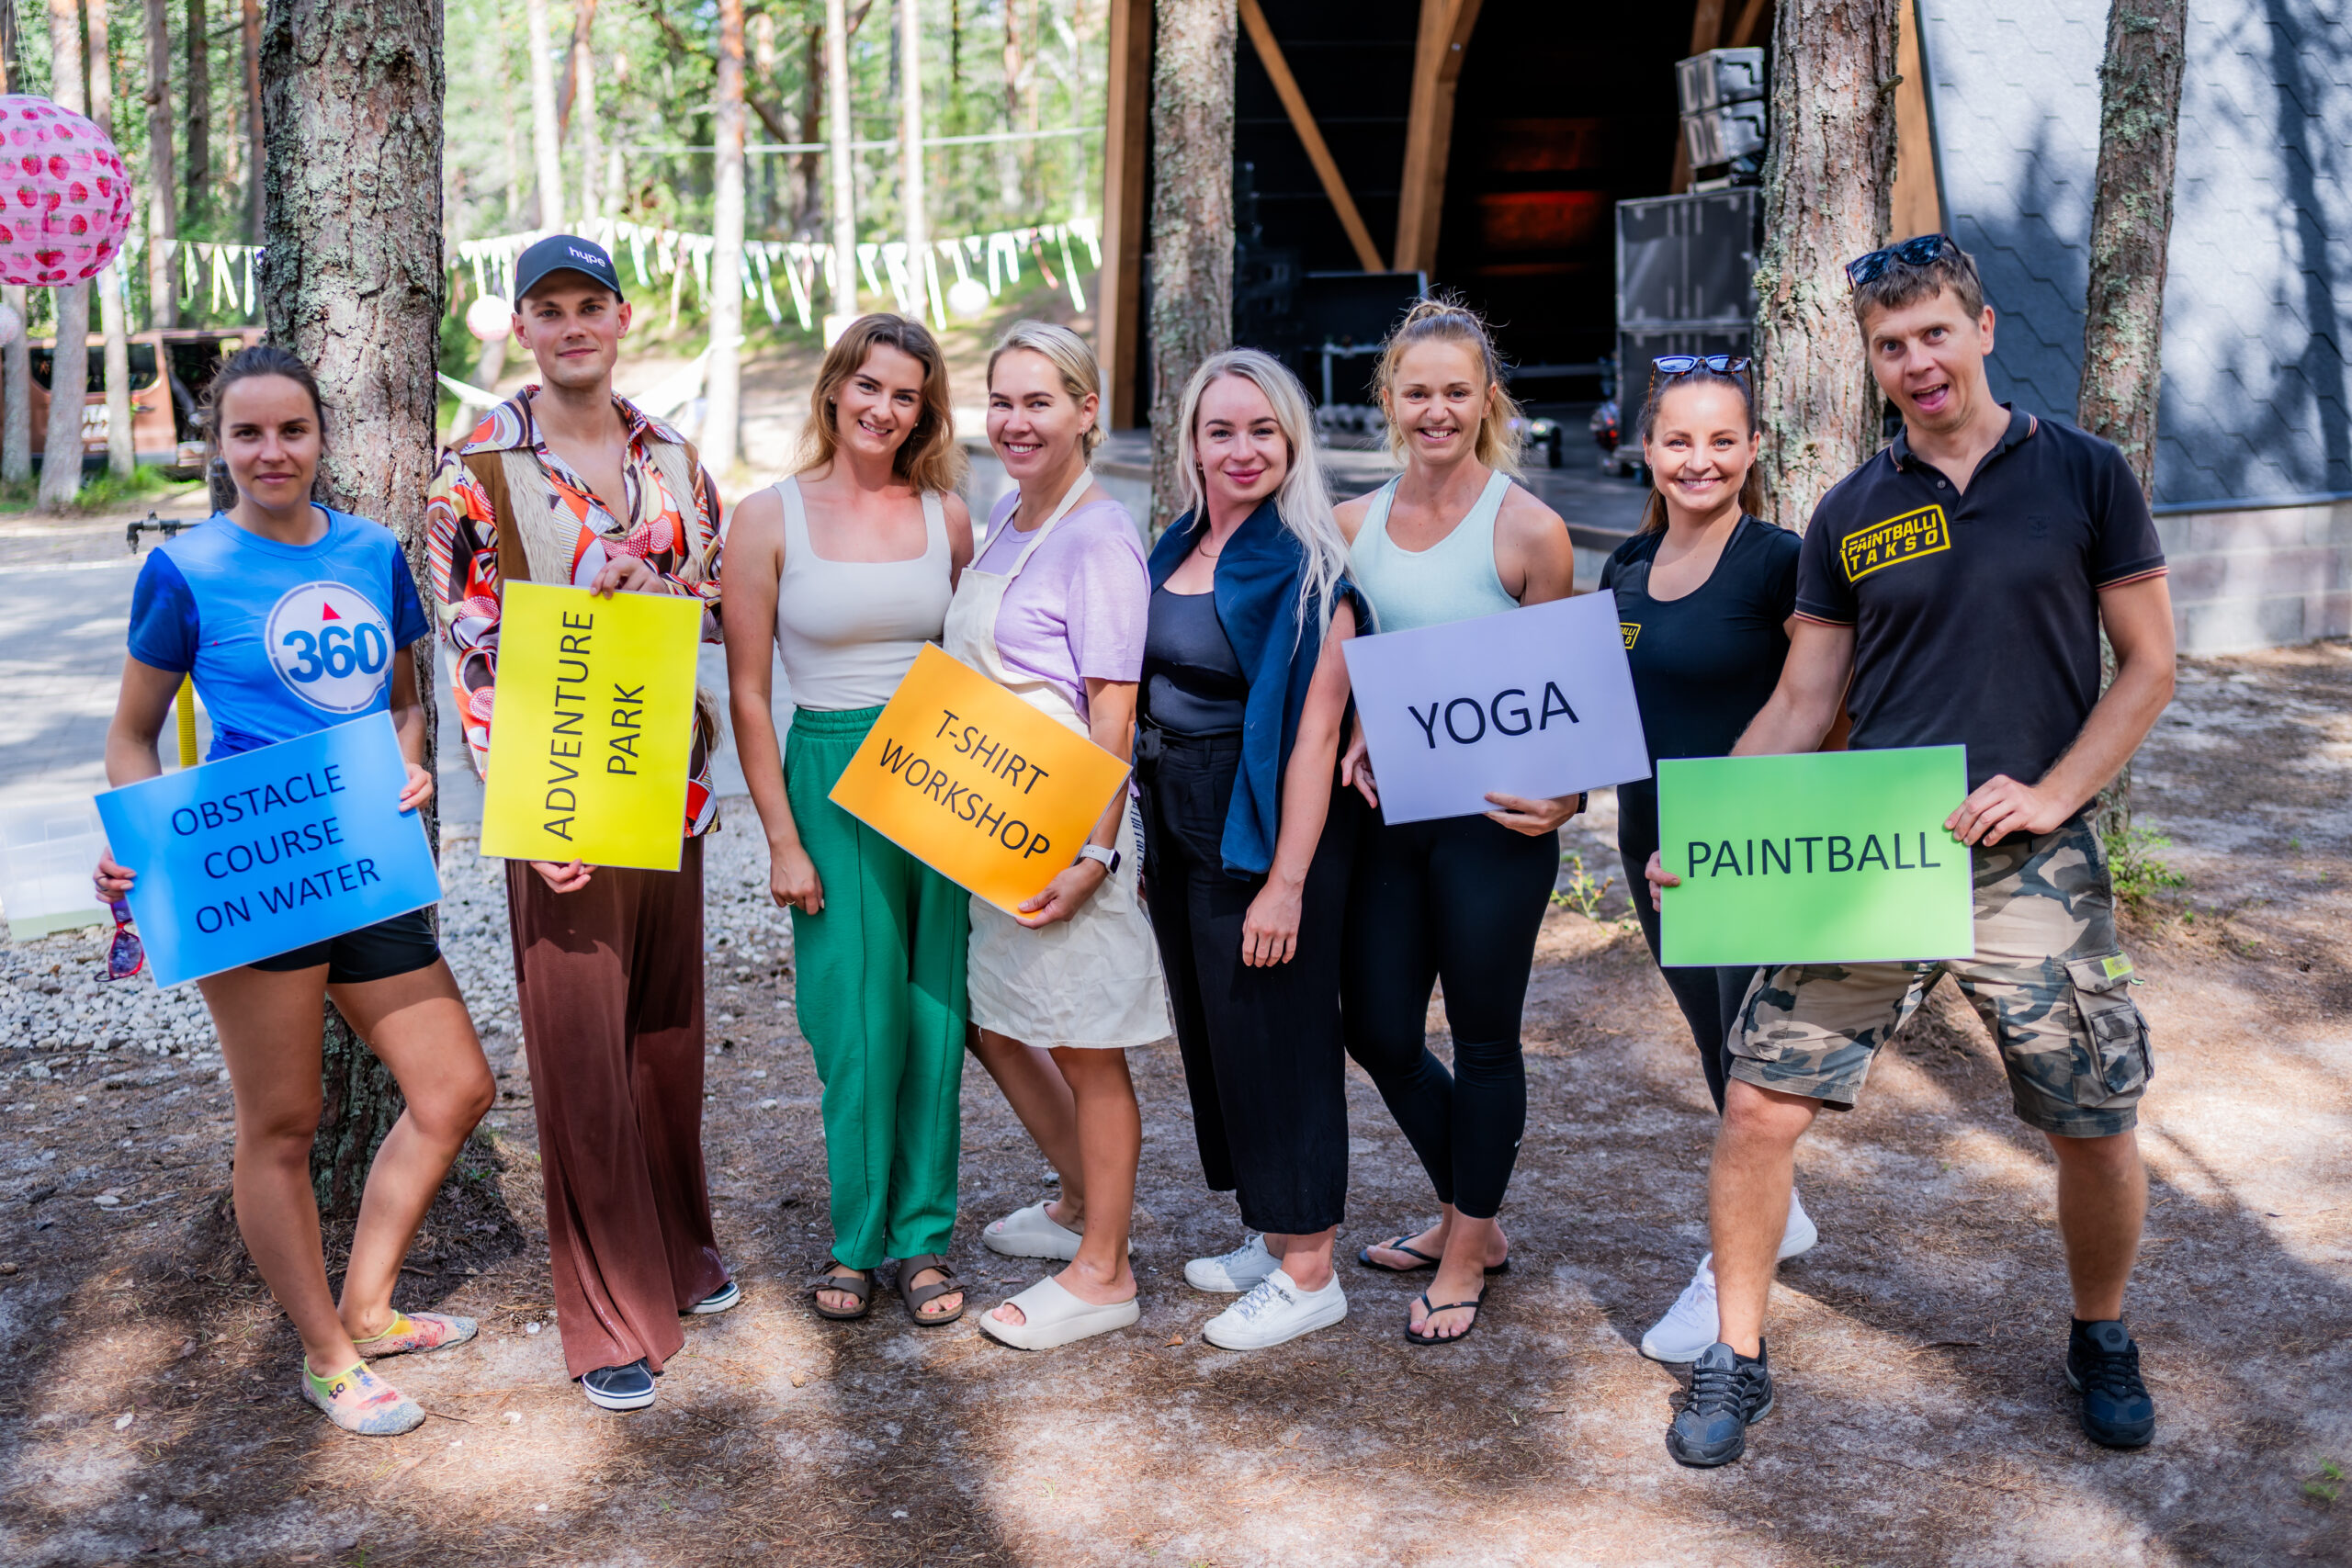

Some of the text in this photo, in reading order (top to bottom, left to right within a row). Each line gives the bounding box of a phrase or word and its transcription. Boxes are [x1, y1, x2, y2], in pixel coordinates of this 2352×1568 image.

[568, 245, 606, 268] hype
[1848, 513, 1938, 556] PAINTBALLI
[1849, 528, 1939, 571] TAKSO
[281, 621, 388, 683] 360
[543, 610, 594, 842] ADVENTURE
[606, 682, 646, 775] PARK
[1407, 681, 1580, 750] YOGA
[935, 708, 1050, 795] T-SHIRT
[171, 763, 346, 838] OBSTACLE
[878, 737, 1052, 861] WORKSHOP
[203, 816, 345, 881] COURSE
[1687, 830, 1942, 879] PAINTBALL
[195, 857, 381, 935] ON WATER
